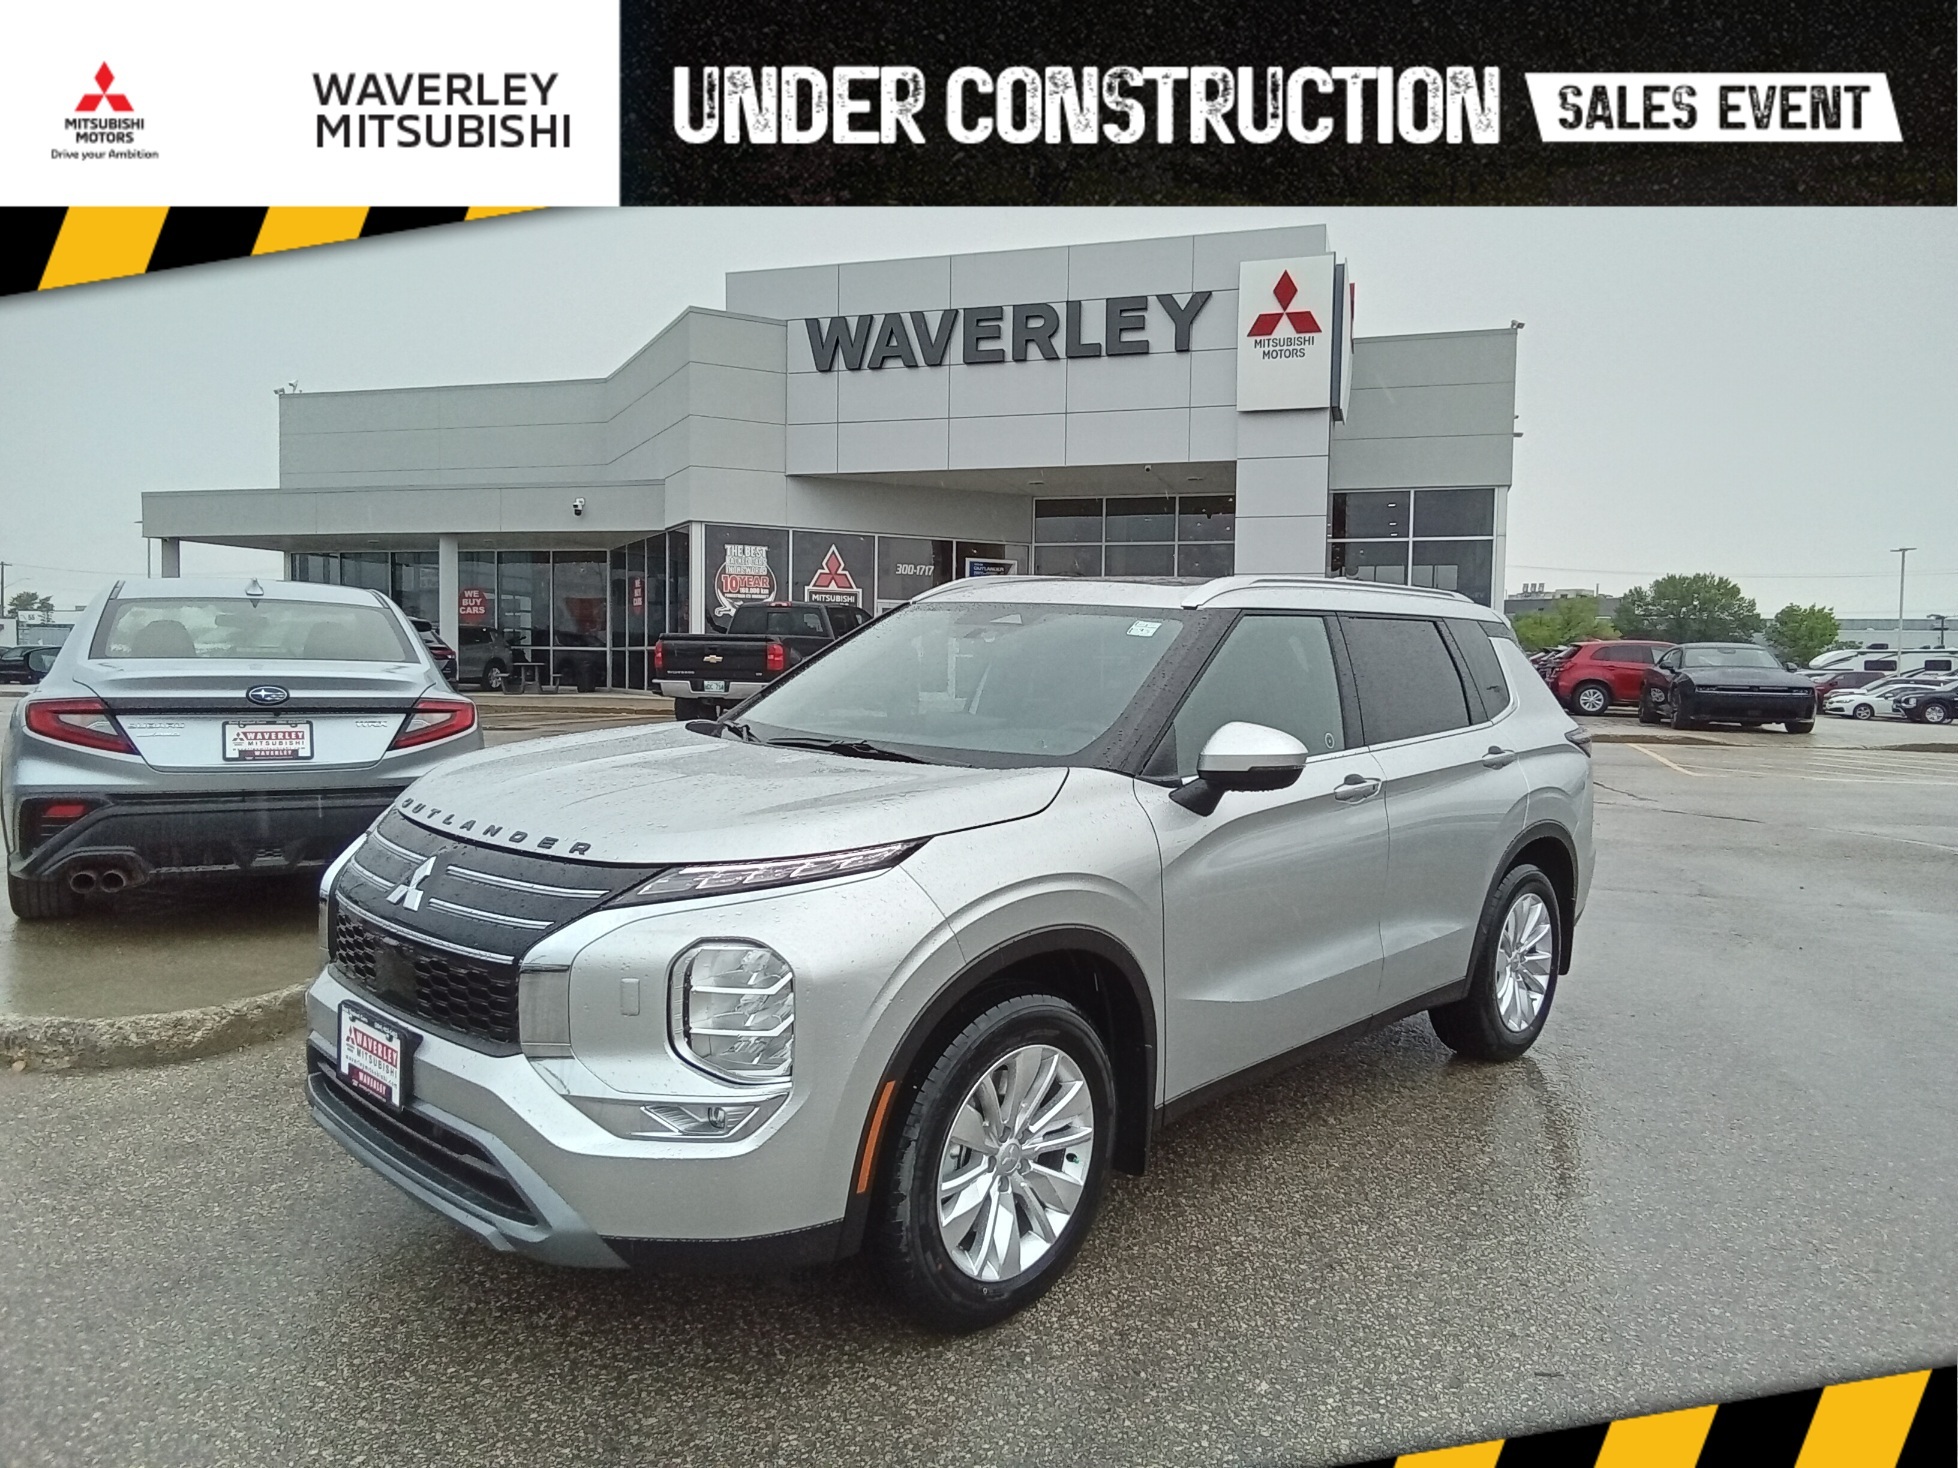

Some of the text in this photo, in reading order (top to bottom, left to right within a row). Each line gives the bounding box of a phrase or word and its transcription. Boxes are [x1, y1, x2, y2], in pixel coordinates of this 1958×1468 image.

[804, 291, 1212, 372] WAVERLEY
[1254, 336, 1315, 349] MITSUBISHI
[1262, 347, 1306, 360] MOTORS
[724, 544, 768, 559] THE BEST
[895, 564, 935, 576] 300-1717
[722, 574, 769, 593] 10 YEAR
[464, 590, 479, 598] WE
[811, 593, 856, 603] MITSUBISHI
[462, 598, 482, 606] BUY
[459, 606, 485, 614] CARS
[246, 731, 304, 740] WAVERLEY
[401, 798, 591, 856] OUTLANDER
[355, 1030, 398, 1067] WAVERLEY
[356, 1047, 398, 1079] MITSUBISHI
[358, 1071, 387, 1095] WAVERLEY
